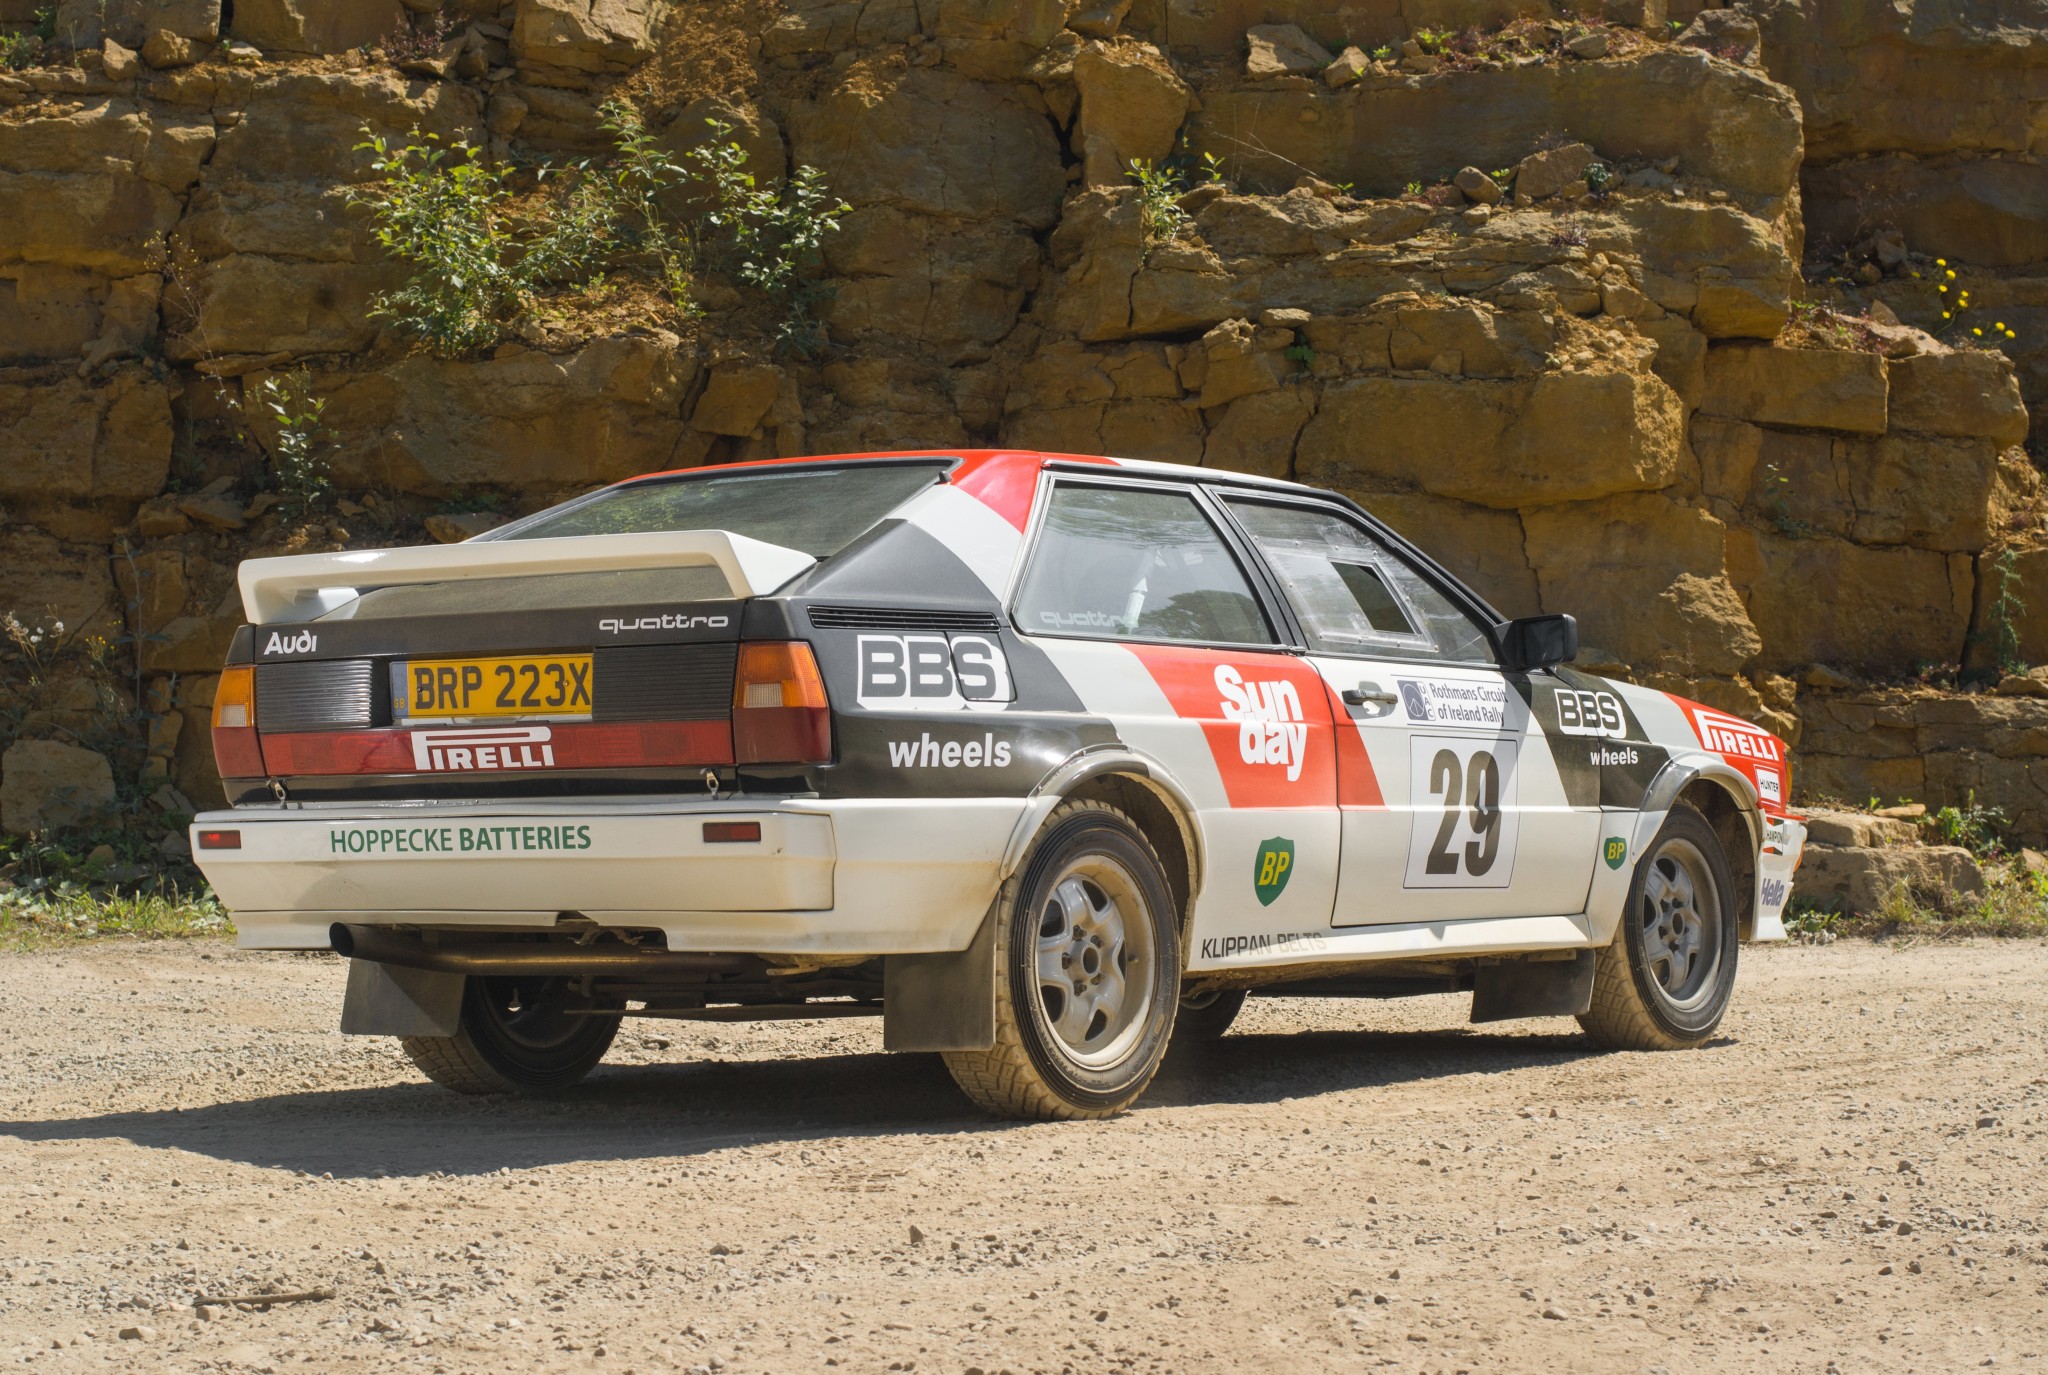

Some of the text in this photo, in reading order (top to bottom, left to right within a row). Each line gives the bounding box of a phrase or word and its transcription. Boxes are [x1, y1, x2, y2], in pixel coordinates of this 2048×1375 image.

[598, 613, 729, 634] quattro
[263, 629, 318, 656] Audi
[414, 661, 592, 710] BRP 223X
[857, 634, 1009, 711] BBS
[393, 697, 405, 709] GB
[1213, 664, 1303, 722] Sun
[1428, 682, 1509, 703] Rothmans Circuit
[1437, 702, 1504, 728] of Ireland Rally
[1554, 688, 1627, 739] BBS
[411, 726, 555, 770] PIRELLI
[1692, 708, 1779, 761] PIRELLI
[888, 733, 1012, 768] wheels
[1239, 721, 1307, 782] day
[1590, 747, 1639, 766] wheels
[1760, 778, 1779, 793] HUNTER
[1425, 748, 1502, 877] 29
[330, 825, 592, 853] HOPPECKE BATTERIES
[1607, 842, 1625, 860] BP
[1766, 830, 1783, 844] HAMPION
[1257, 851, 1290, 886] BP
[1760, 878, 1785, 907] Hella
[1201, 932, 1327, 959] KLIPPAN BELTS
